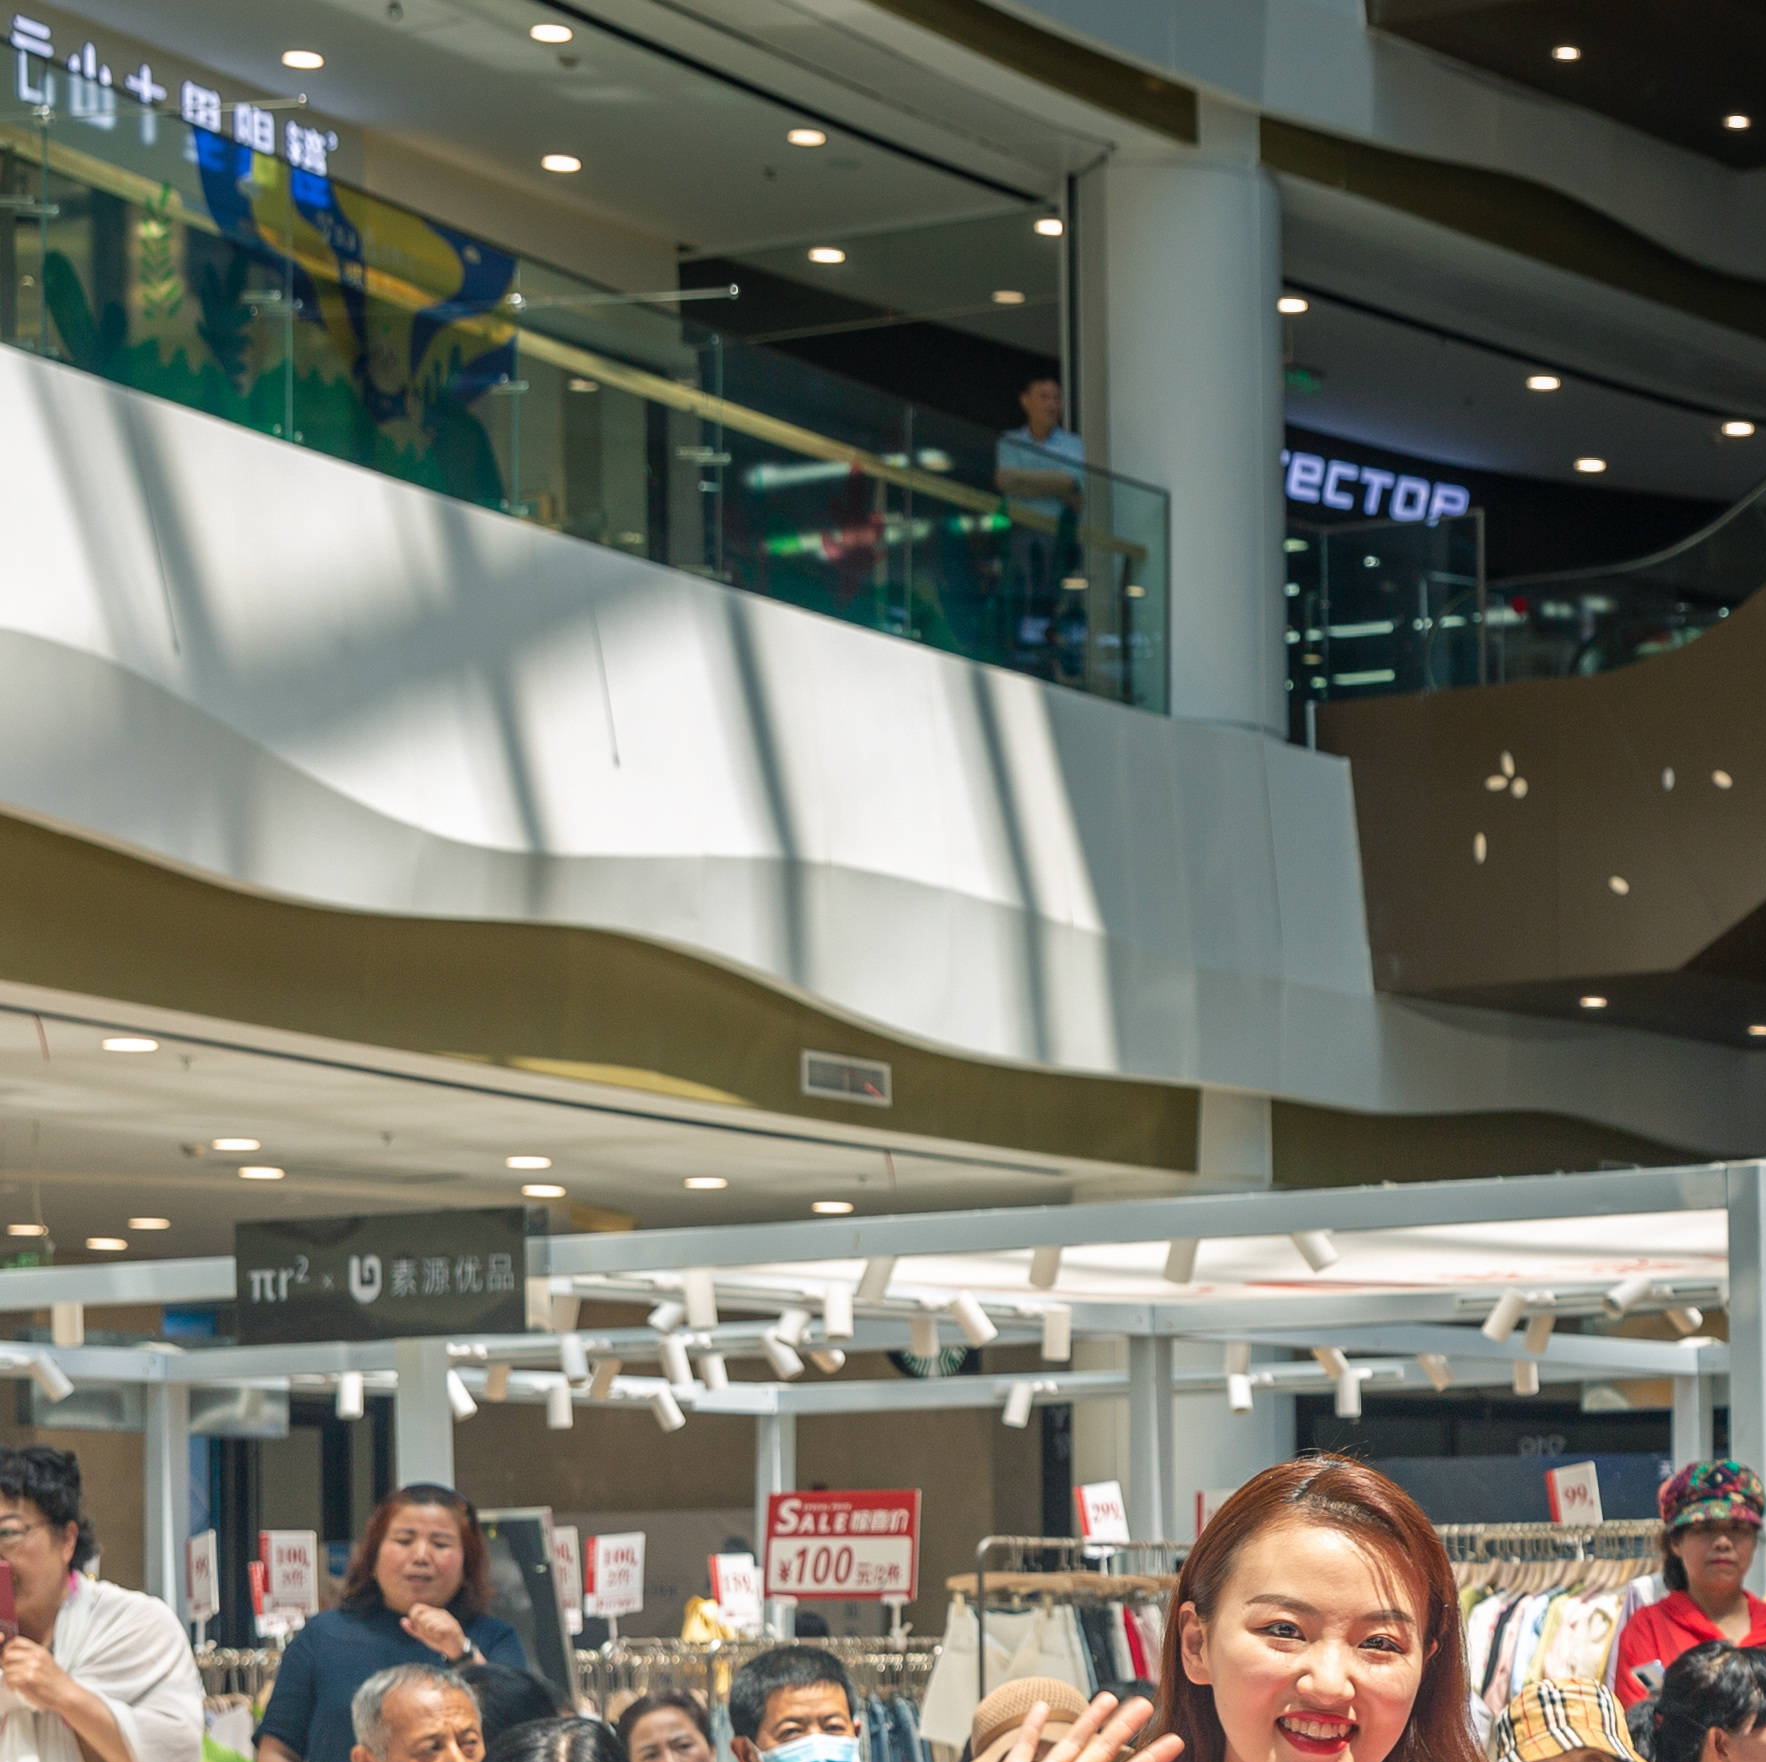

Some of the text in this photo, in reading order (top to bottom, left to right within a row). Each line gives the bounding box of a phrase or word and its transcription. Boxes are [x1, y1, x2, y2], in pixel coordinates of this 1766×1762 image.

[390, 1253, 515, 1298] 素源优品
[775, 1498, 849, 1535] SALE
